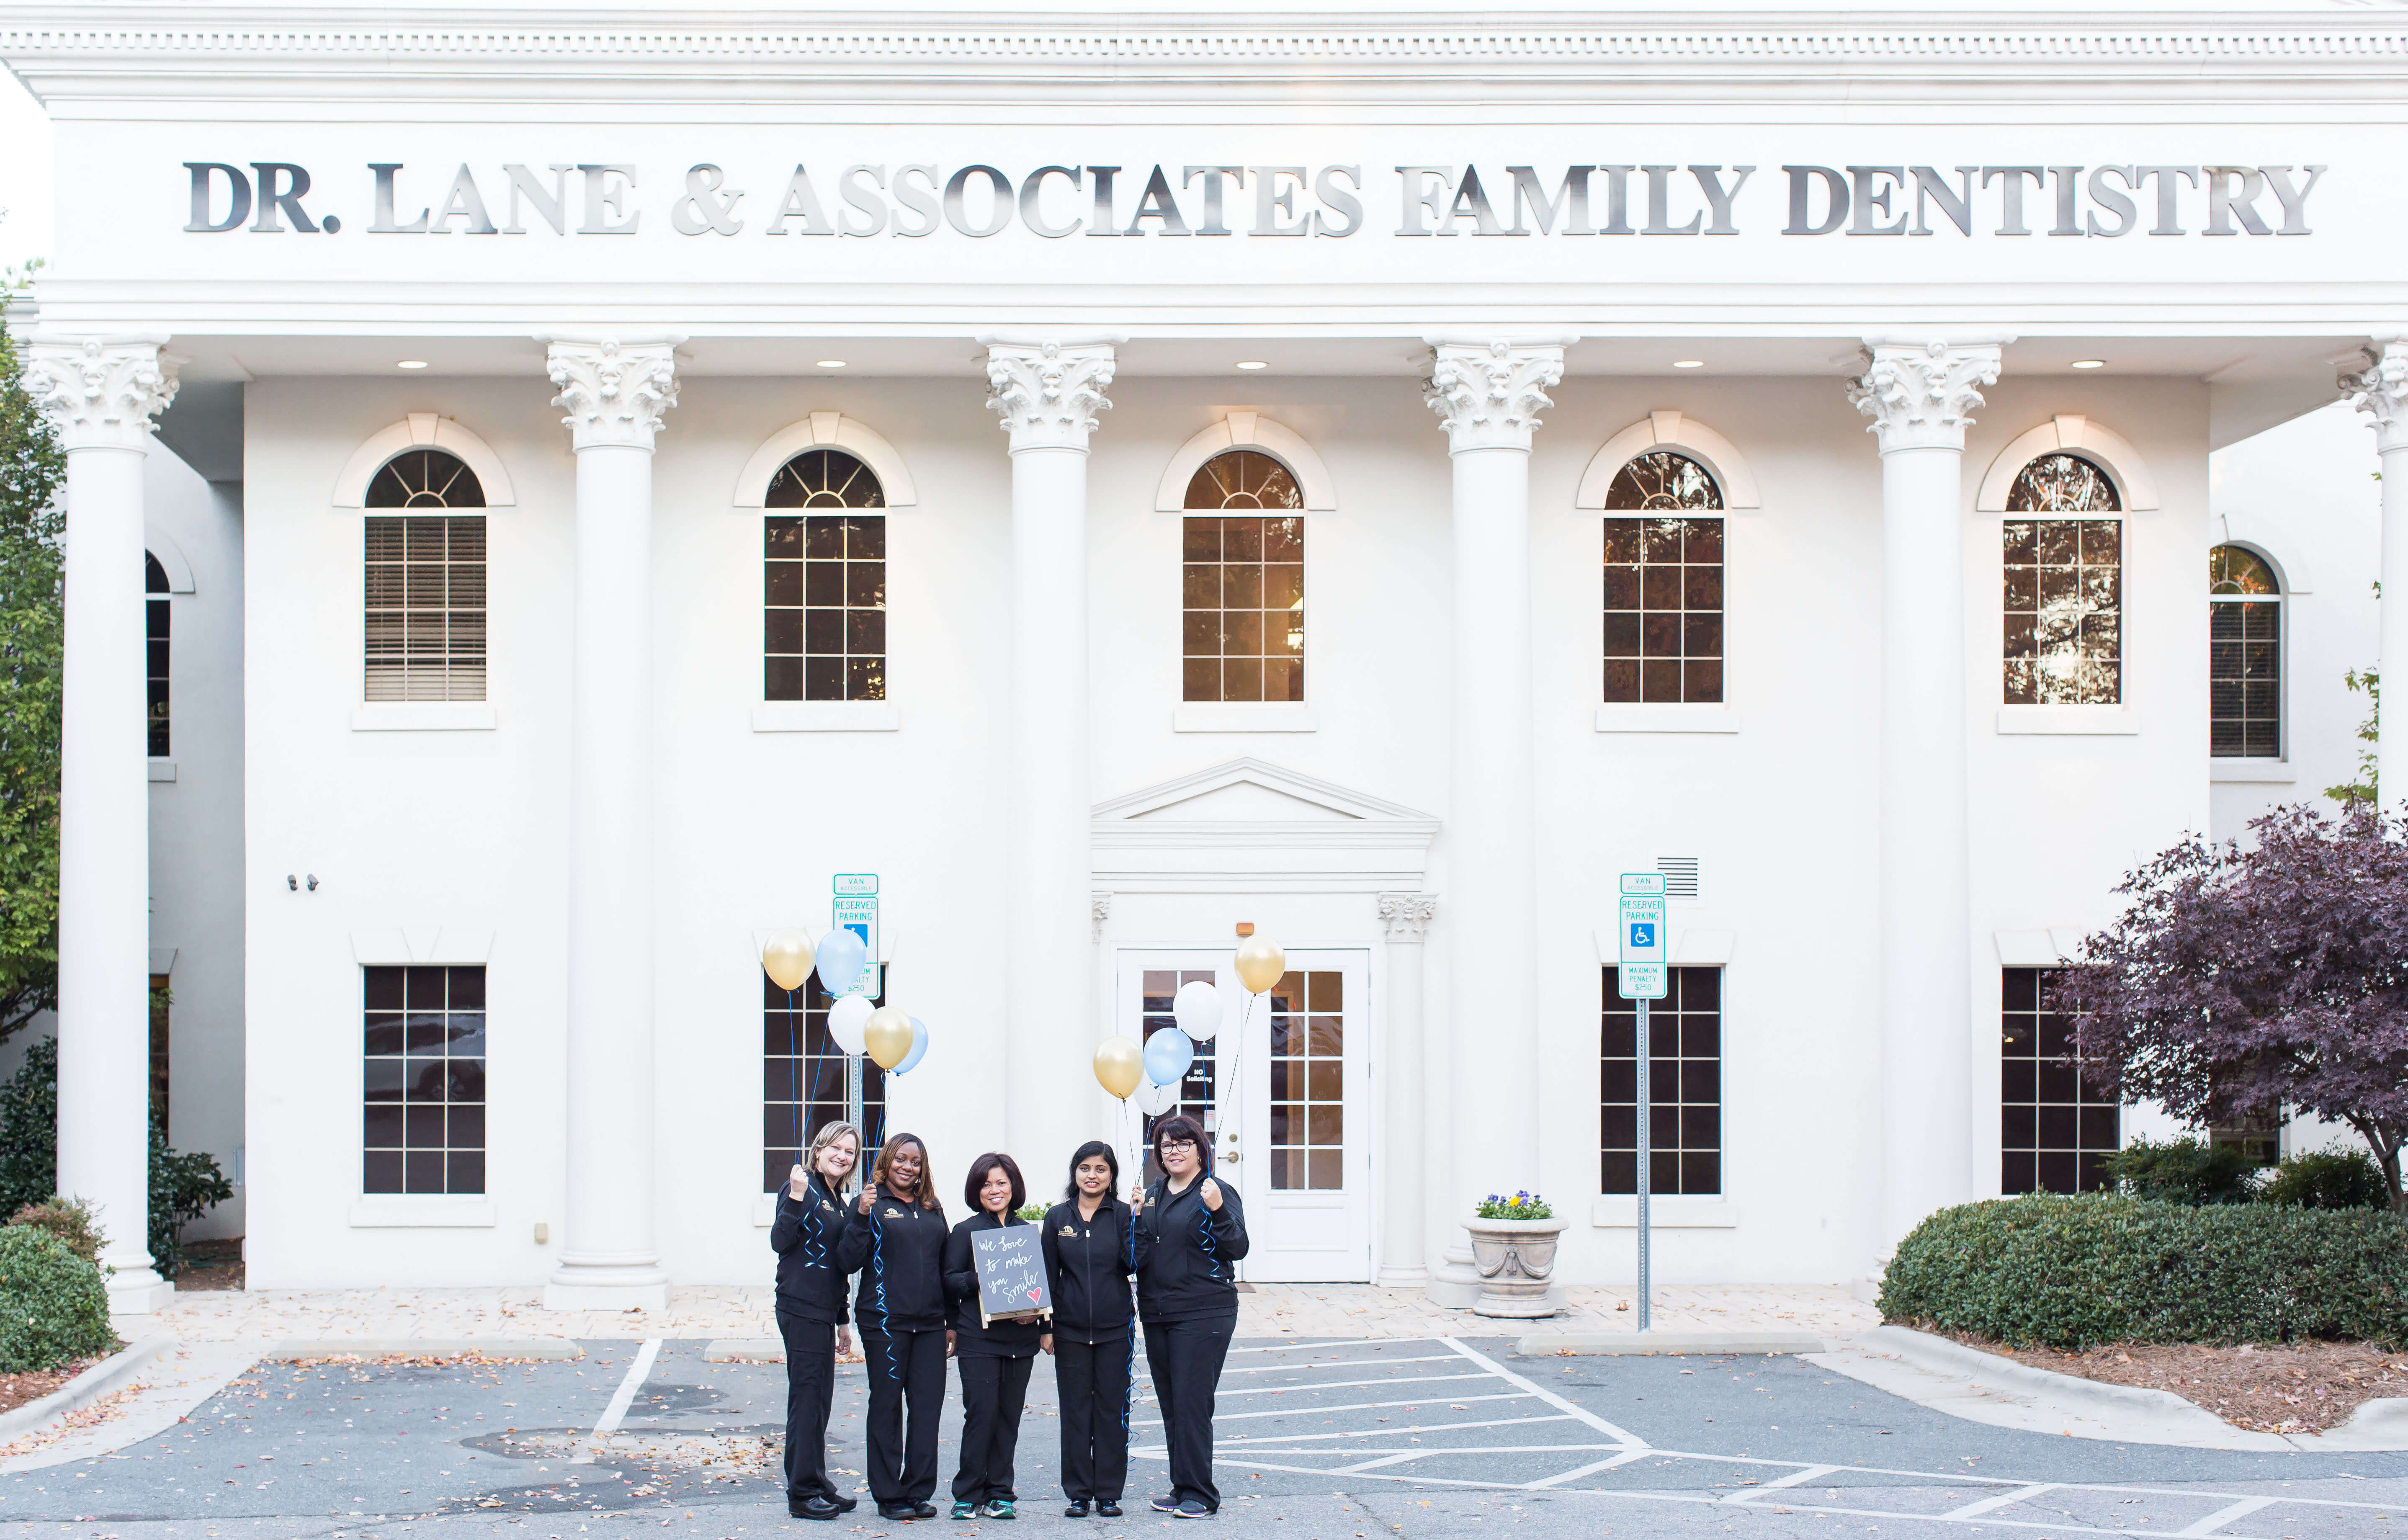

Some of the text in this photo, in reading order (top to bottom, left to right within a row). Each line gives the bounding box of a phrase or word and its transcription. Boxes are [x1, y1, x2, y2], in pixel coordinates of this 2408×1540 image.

[183, 162, 2328, 238] DR. LANE & ASSOCIATES FAMILY DENTISTRY
[979, 1239, 997, 1251] We
[985, 1252, 1032, 1274] to make
[988, 1277, 1007, 1294] you
